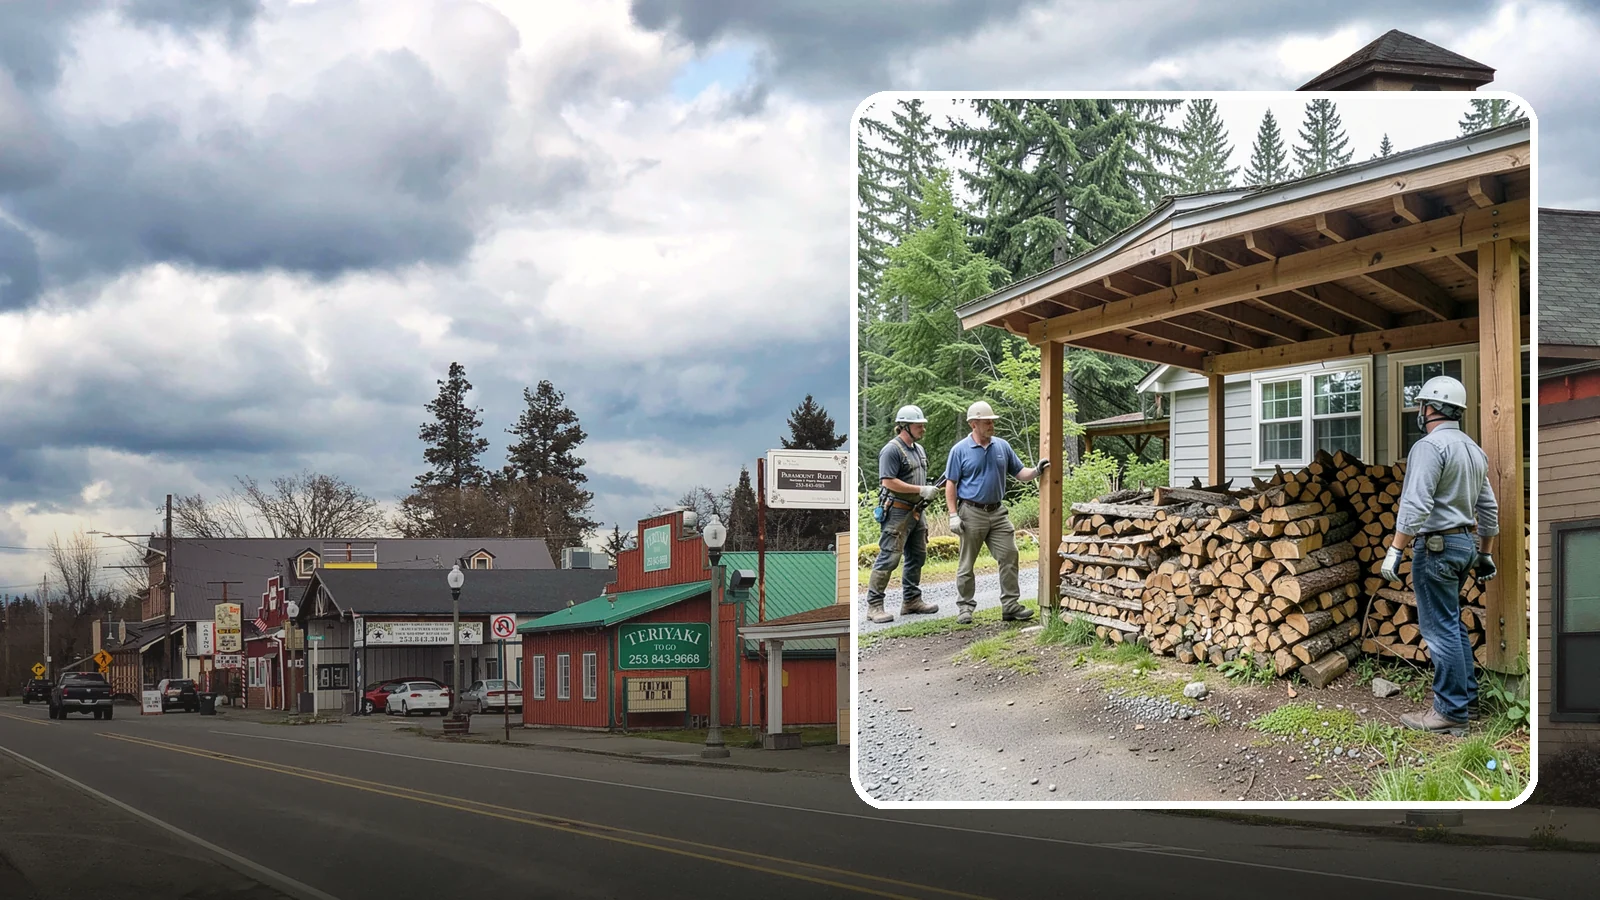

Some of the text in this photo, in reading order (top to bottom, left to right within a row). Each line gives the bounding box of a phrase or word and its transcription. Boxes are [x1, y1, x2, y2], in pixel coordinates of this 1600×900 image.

[781, 471, 839, 480] PARAMOUNT REALTY
[624, 627, 702, 646] TERIYAKI
[628, 653, 700, 665] 253 843-9668
[639, 681, 673, 691] TERIYAKI
